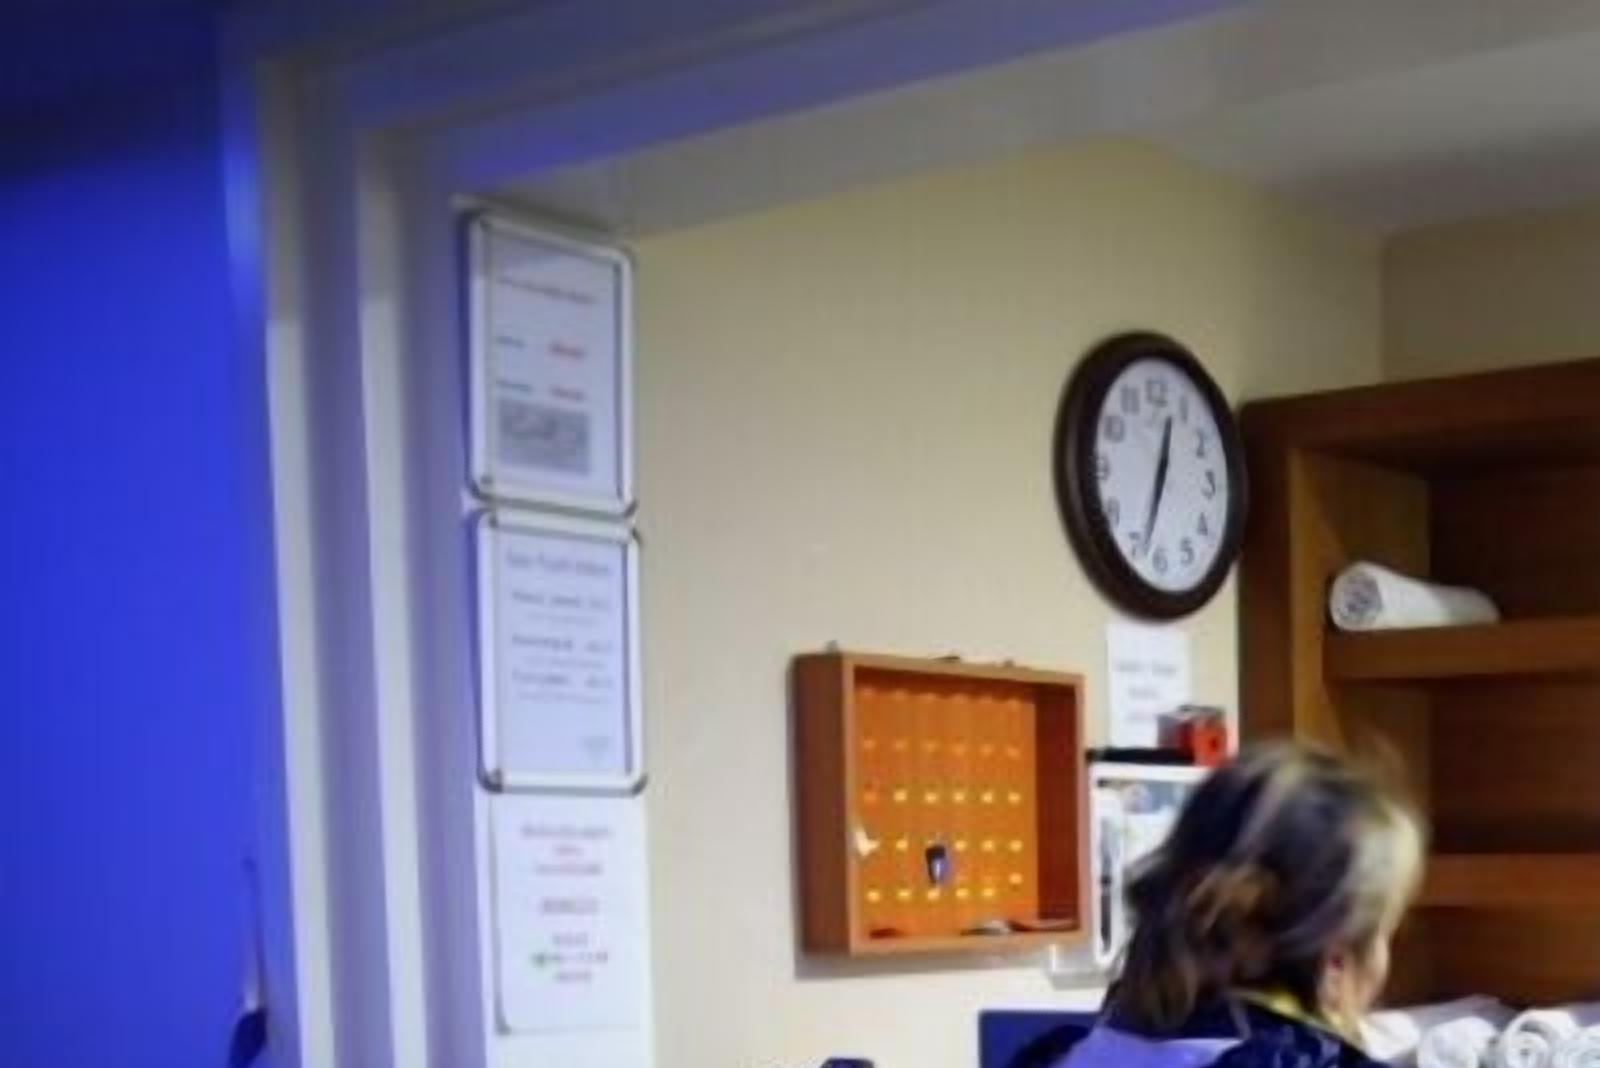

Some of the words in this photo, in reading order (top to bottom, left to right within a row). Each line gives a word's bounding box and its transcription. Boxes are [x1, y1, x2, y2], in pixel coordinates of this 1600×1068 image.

[1146, 379, 1168, 408] 12
[1202, 470, 1216, 500] 3
[1152, 545, 1168, 574] 6
[1180, 537, 1195, 566] 5
